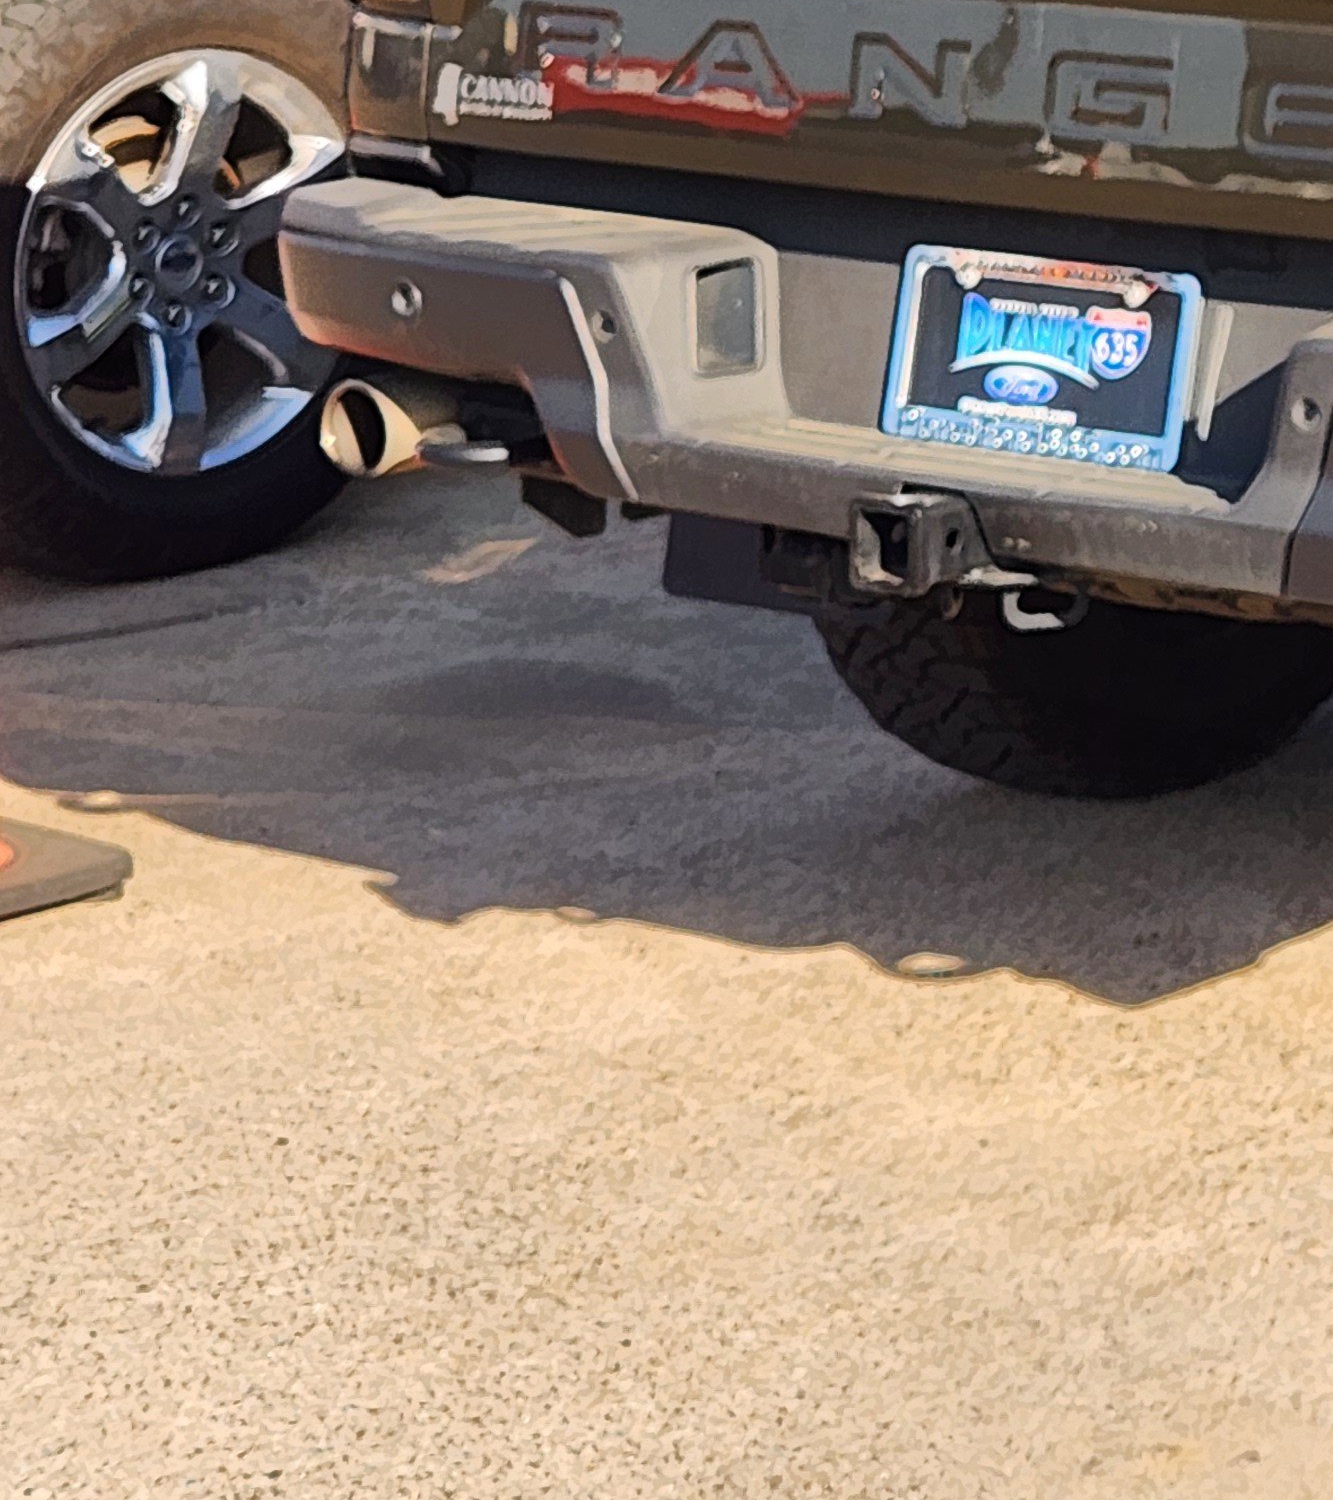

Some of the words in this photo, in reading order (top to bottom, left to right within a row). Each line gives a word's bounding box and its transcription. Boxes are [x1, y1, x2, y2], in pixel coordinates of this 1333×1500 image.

[460, 72, 555, 107] CANNON
[956, 292, 1099, 375] PLANET
[1092, 330, 1140, 366] 635
